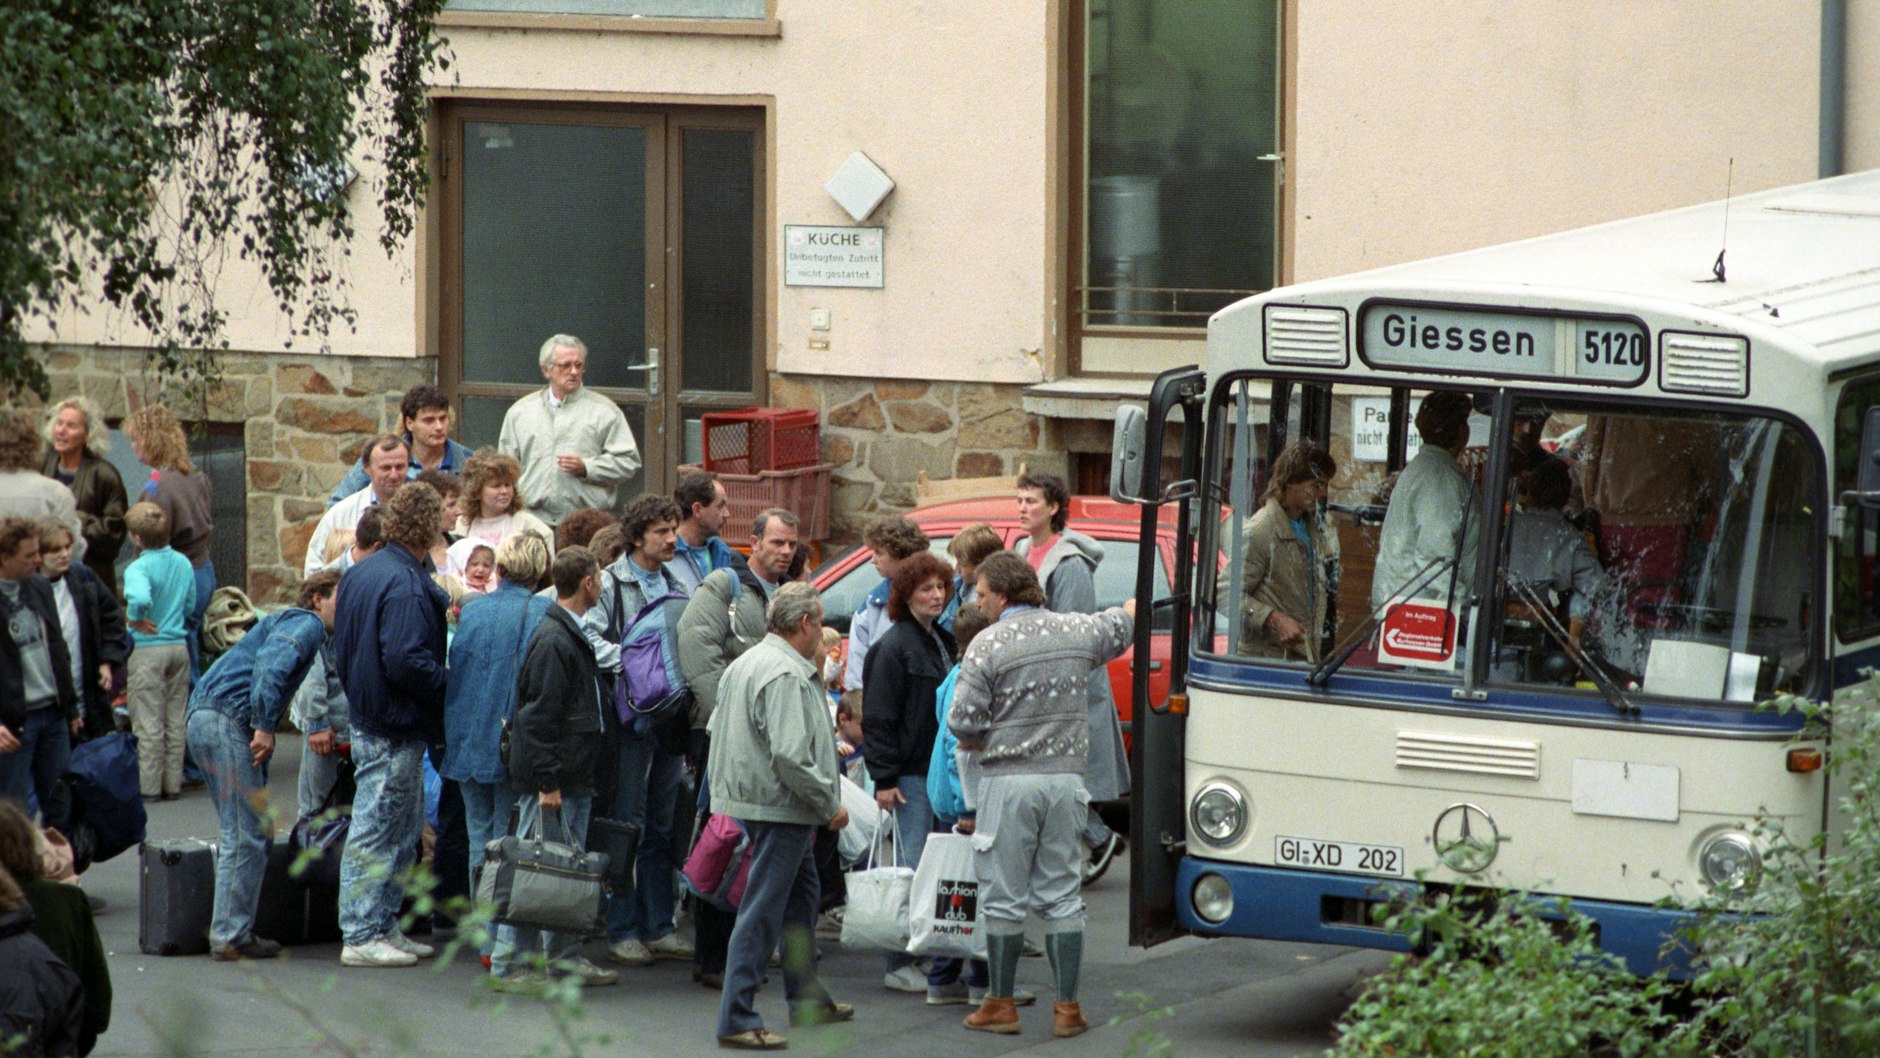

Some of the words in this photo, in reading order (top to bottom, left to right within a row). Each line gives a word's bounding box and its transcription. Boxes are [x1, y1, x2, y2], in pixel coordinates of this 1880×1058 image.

[808, 233, 860, 246] KÜCHE
[798, 270, 821, 278] nicht
[825, 270, 870, 279] gestattet
[1383, 313, 1535, 357] Giessen
[1585, 330, 1645, 367] 5120
[1356, 429, 1383, 446] nicht
[1414, 612, 1437, 622] Auftrag
[1358, 847, 1397, 872] 202
[937, 880, 978, 897] fashion
